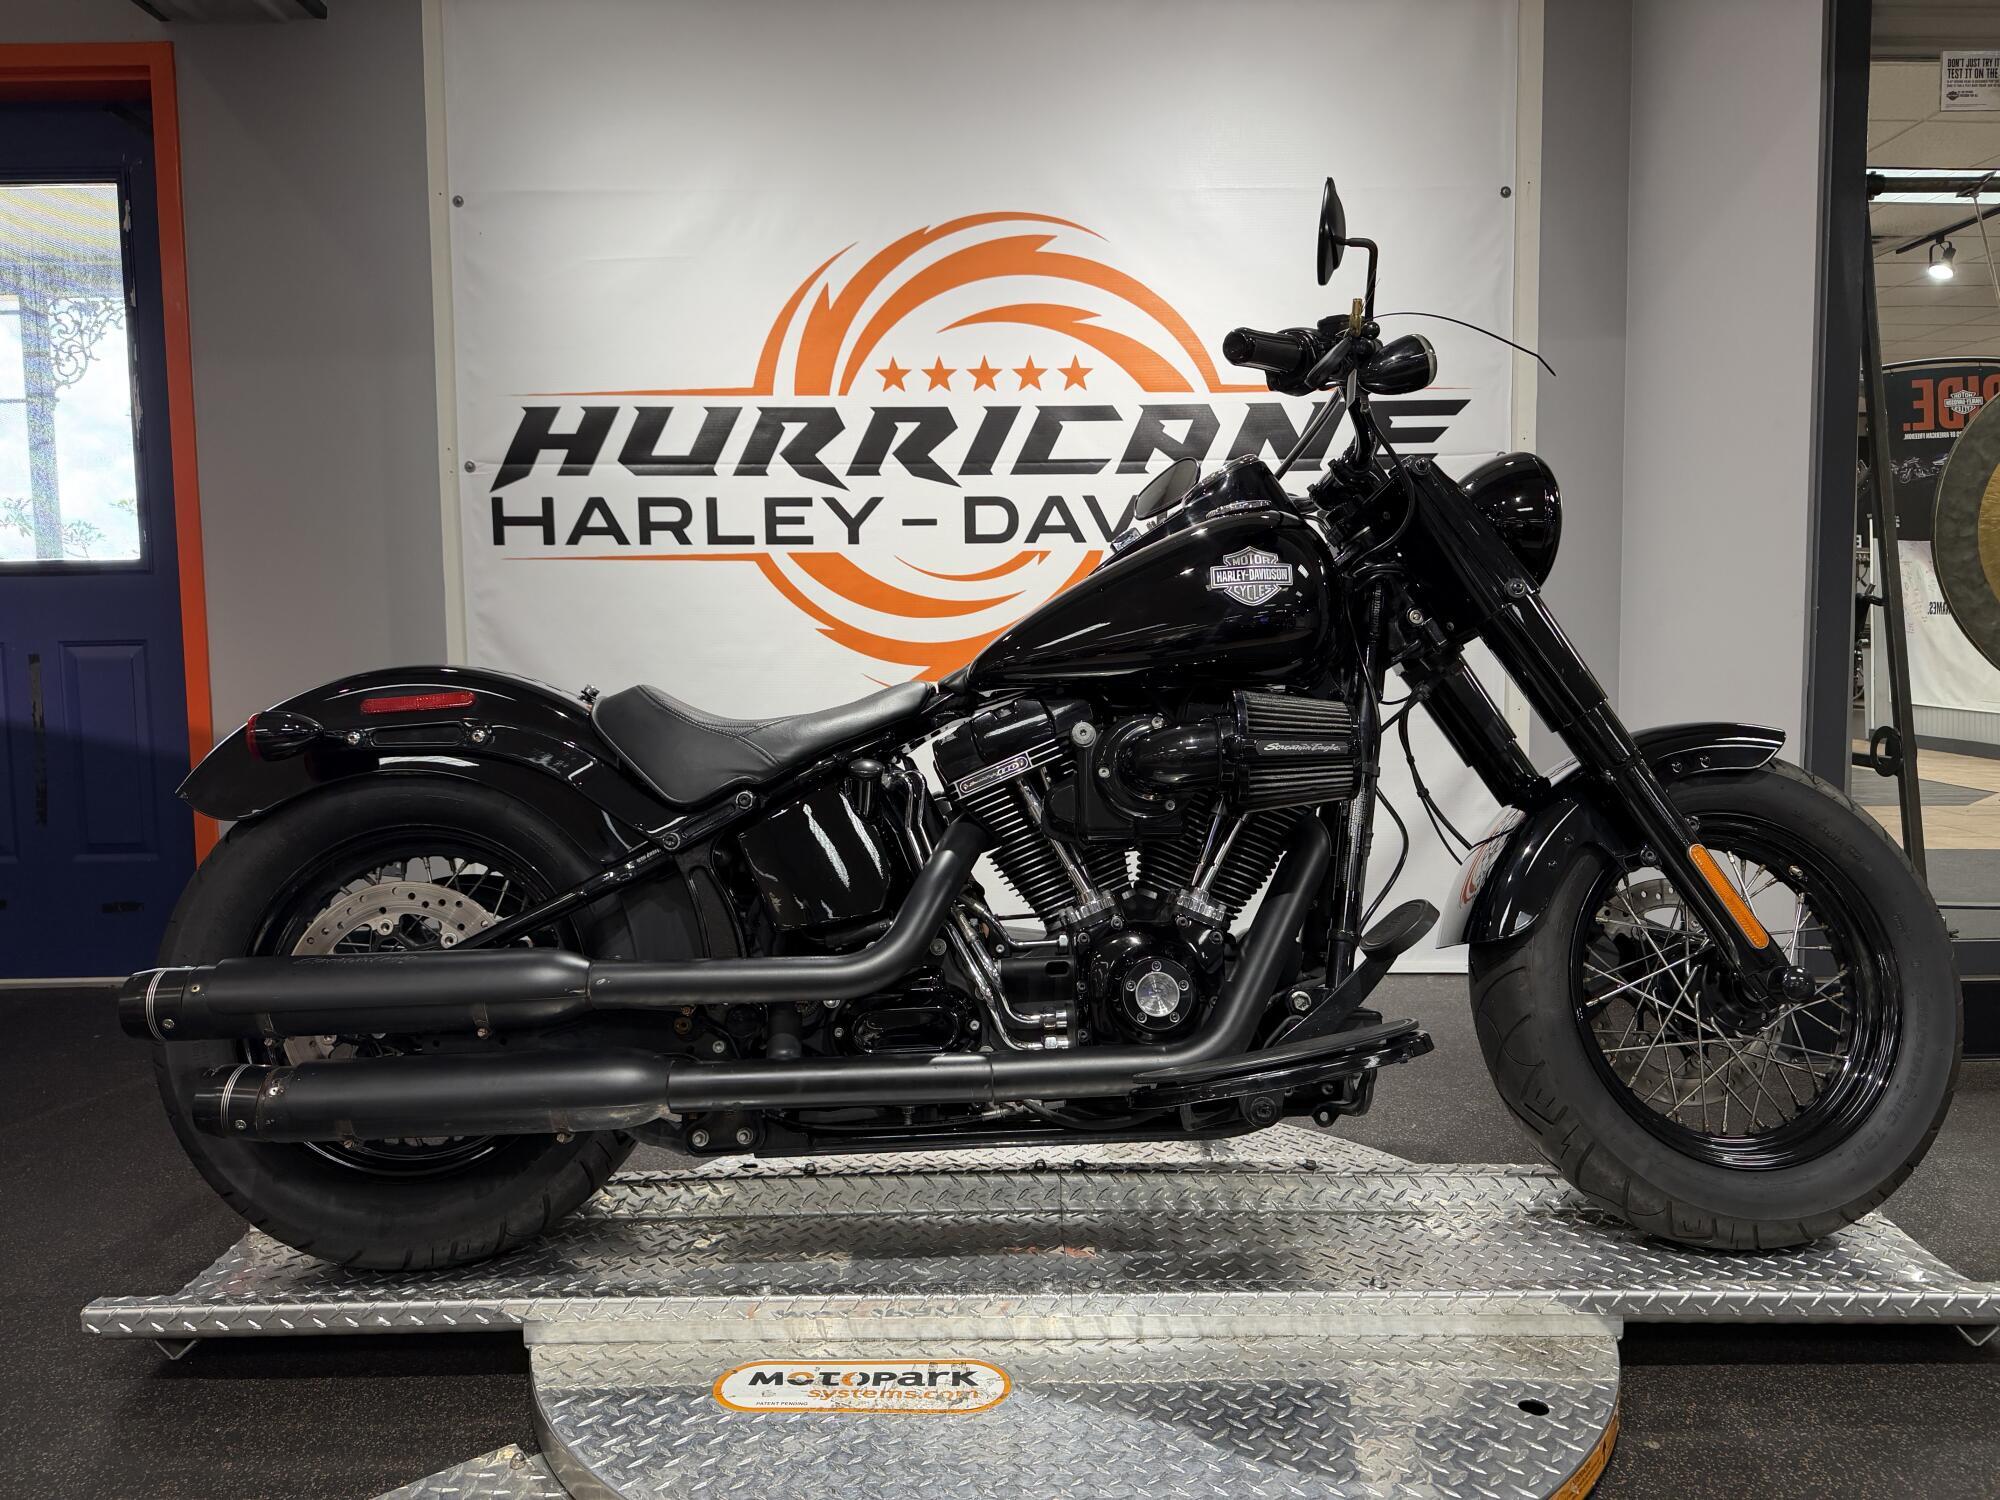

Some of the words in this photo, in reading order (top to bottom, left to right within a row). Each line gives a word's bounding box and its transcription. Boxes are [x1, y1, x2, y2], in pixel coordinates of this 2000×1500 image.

[1947, 59, 1964, 68] DON'T
[1966, 59, 1980, 68] JUST
[1983, 59, 1993, 68] TRY
[1947, 68, 1963, 79] TEST
[1965, 68, 1972, 79] IT
[1974, 68, 1984, 79] ON
[1987, 69, 1998, 79] THE
[490, 400, 1471, 492] HURRICANE
[1232, 553, 1270, 566] MOTOR
[1216, 568, 1288, 583] HARLEY-DAVIDSON
[1233, 584, 1273, 601] CYCLES
